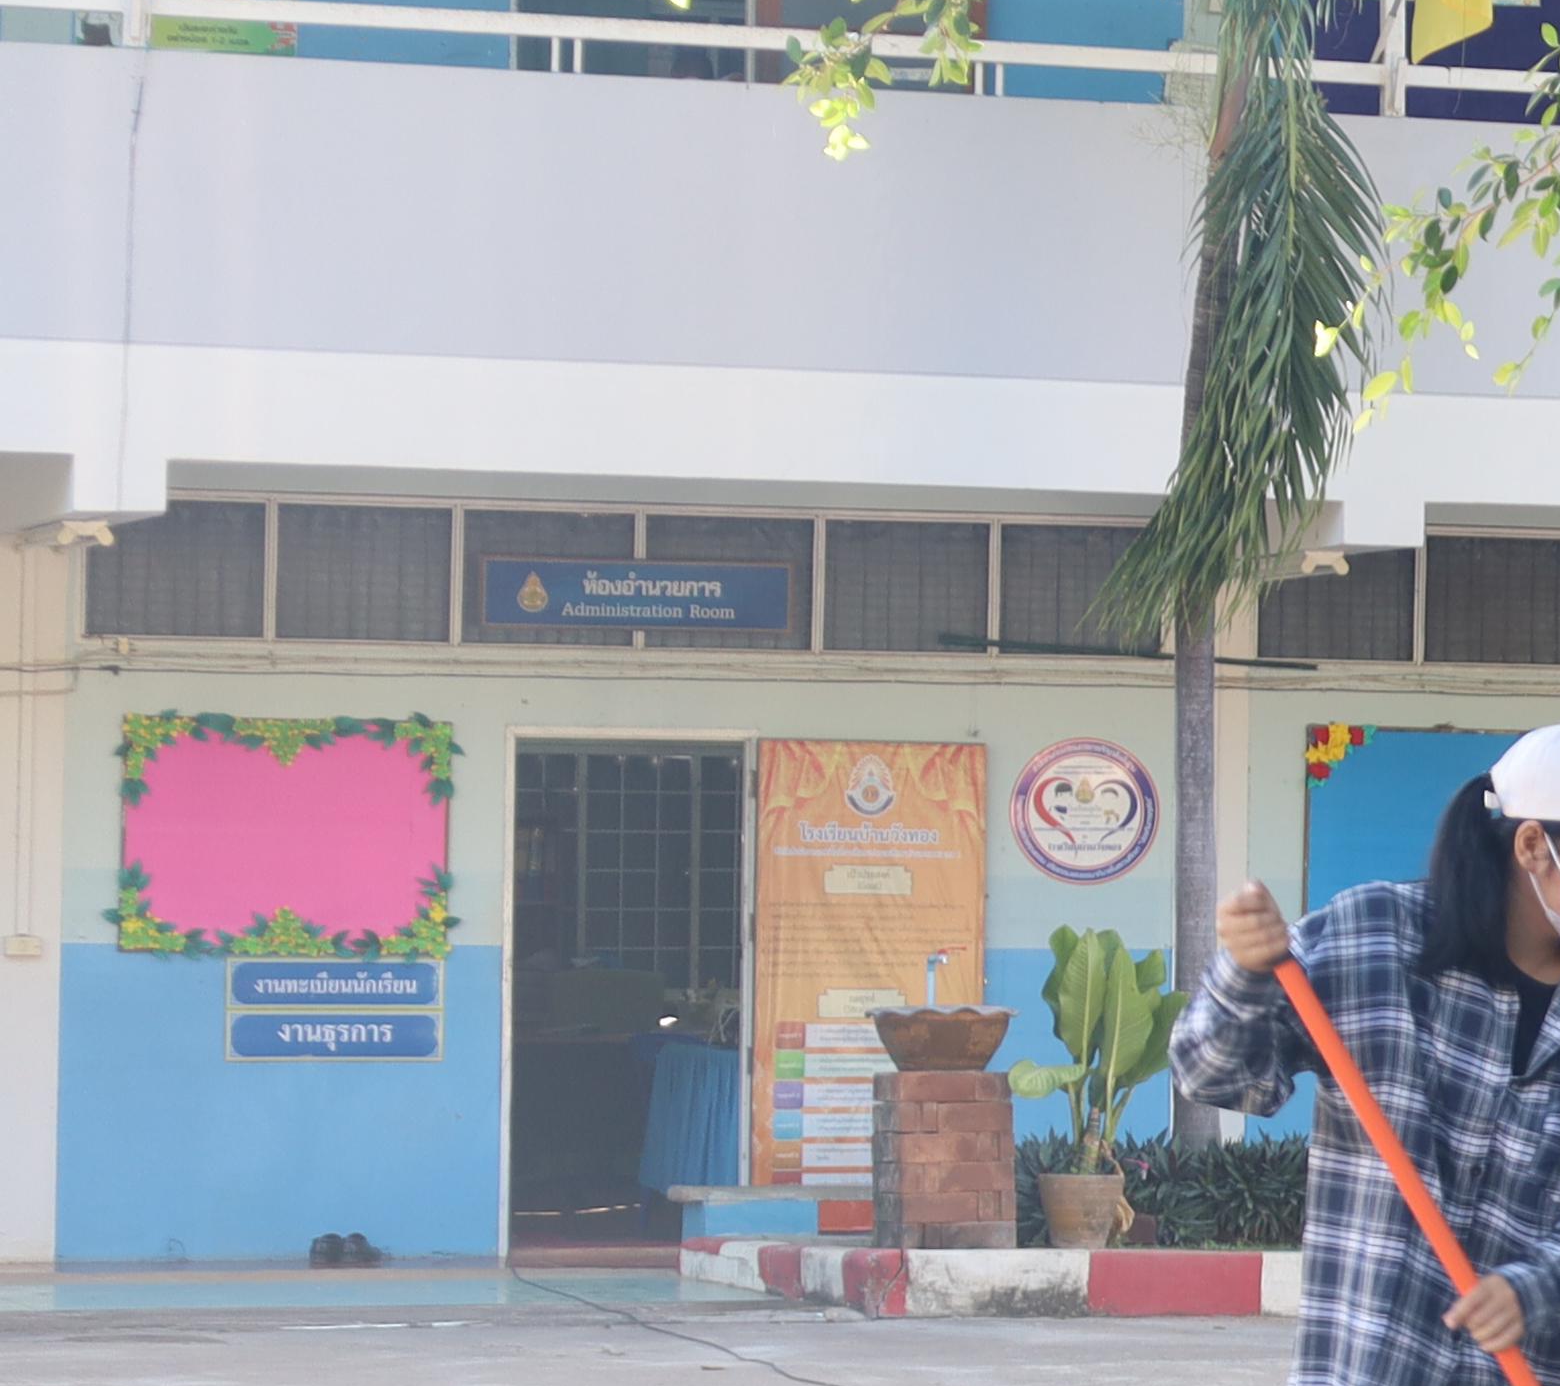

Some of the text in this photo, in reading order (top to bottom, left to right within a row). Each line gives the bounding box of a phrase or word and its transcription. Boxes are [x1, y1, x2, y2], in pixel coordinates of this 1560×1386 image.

[583, 570, 722, 599] ห้องอำนวยการ
[562, 601, 736, 620] Administration Room
[254, 970, 418, 995] งานทะเบียนนักเรียน
[277, 1023, 394, 1052] งานธุรการ
